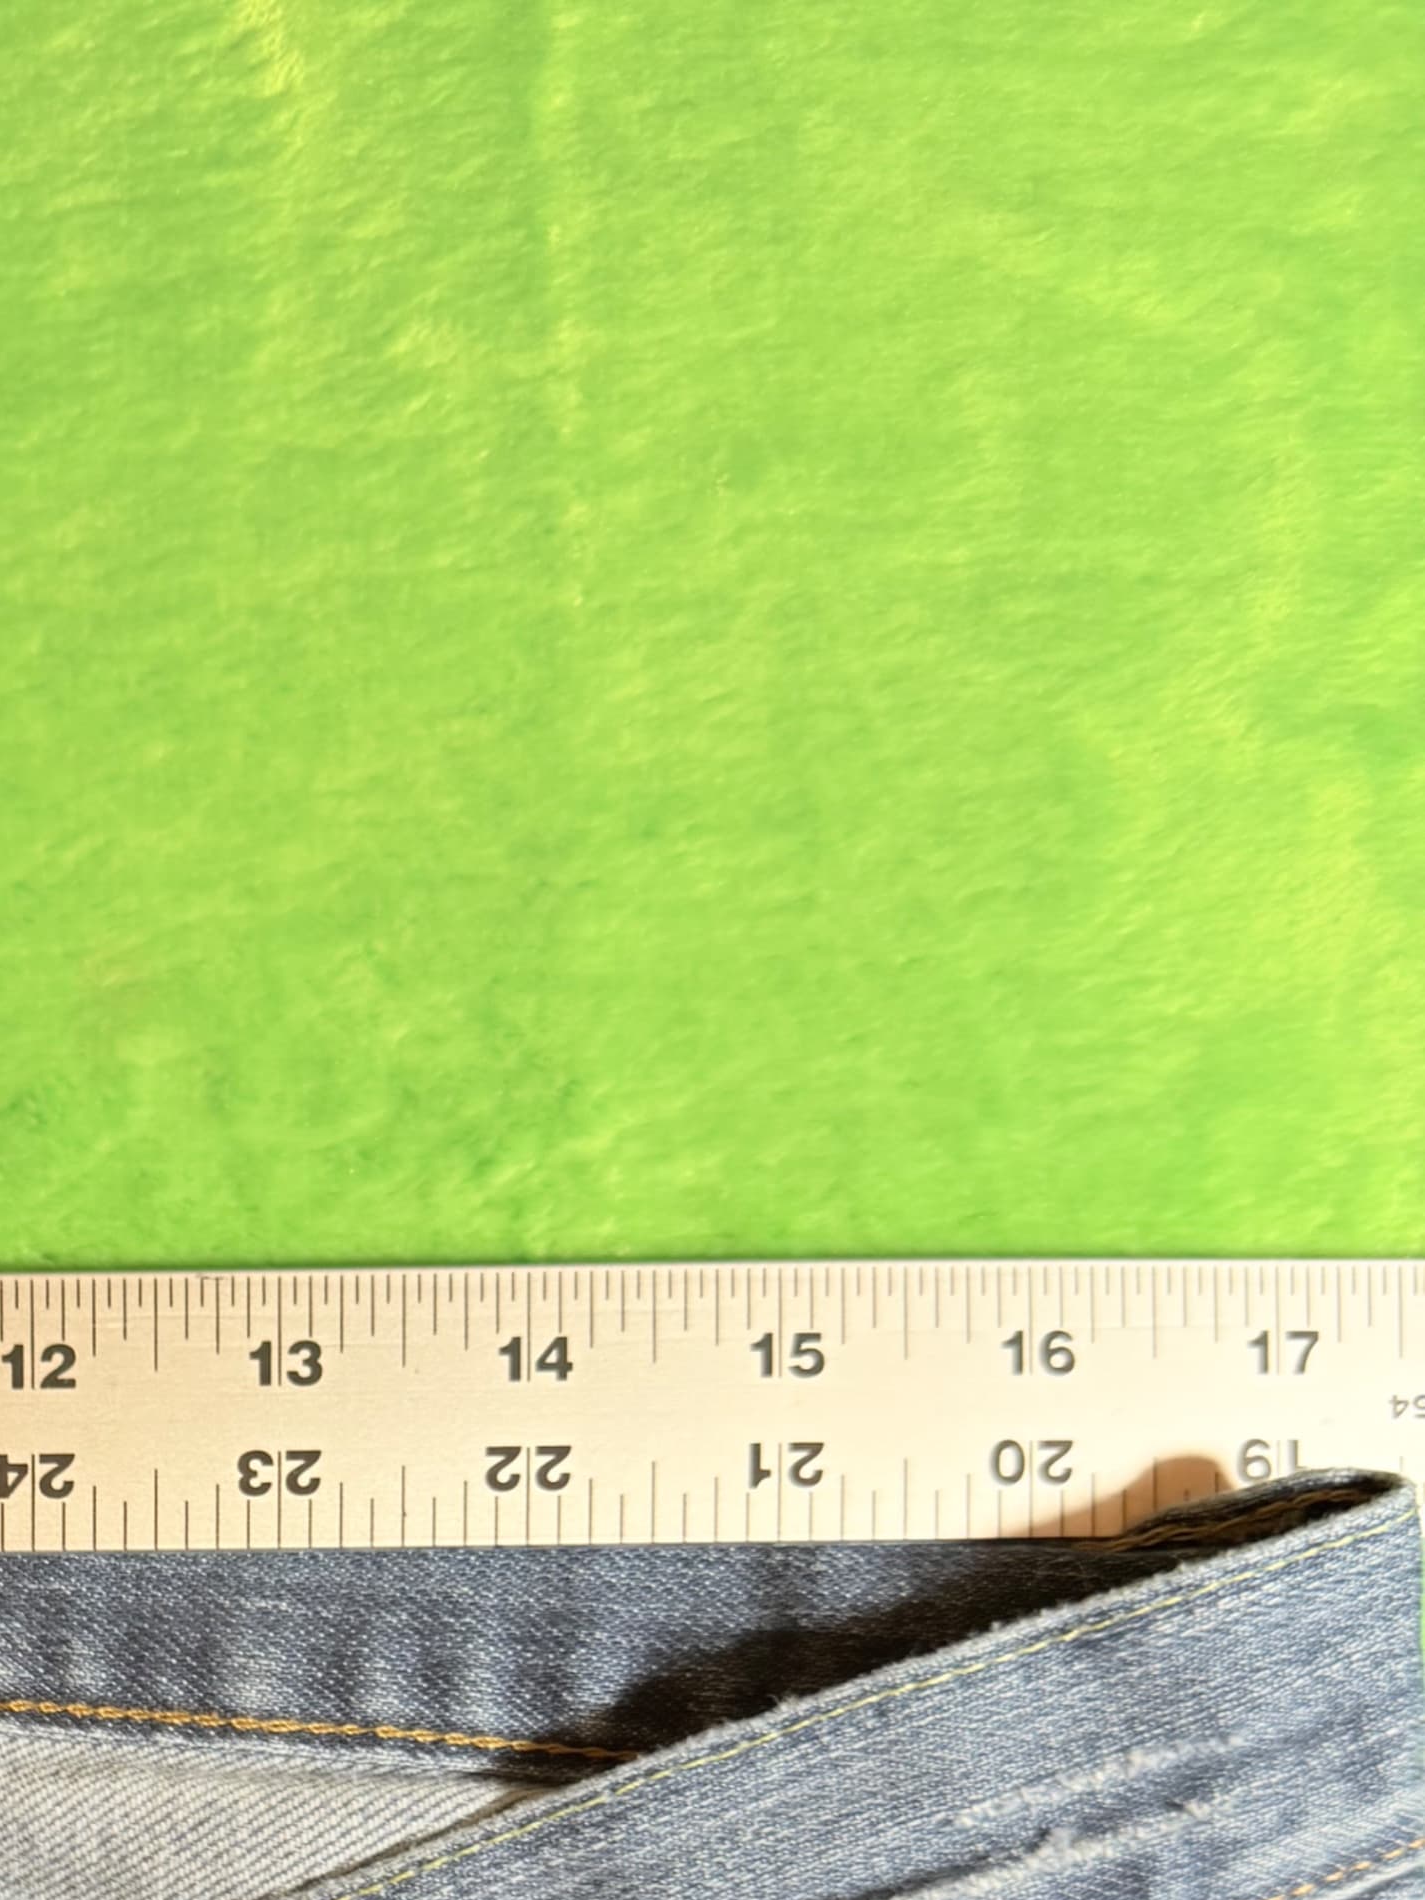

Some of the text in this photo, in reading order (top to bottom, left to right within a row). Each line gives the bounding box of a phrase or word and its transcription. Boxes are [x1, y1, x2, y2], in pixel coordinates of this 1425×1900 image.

[0, 1341, 78, 1392] 12
[247, 1338, 325, 1388] 13
[497, 1334, 575, 1383] 14
[749, 1330, 827, 1380] 15
[1001, 1328, 1077, 1377] 16
[1246, 1328, 1321, 1376] 17
[235, 1448, 323, 1498] 23
[483, 1443, 573, 1494] 22
[747, 1440, 826, 1490] 21
[989, 1438, 1075, 1487] 20
